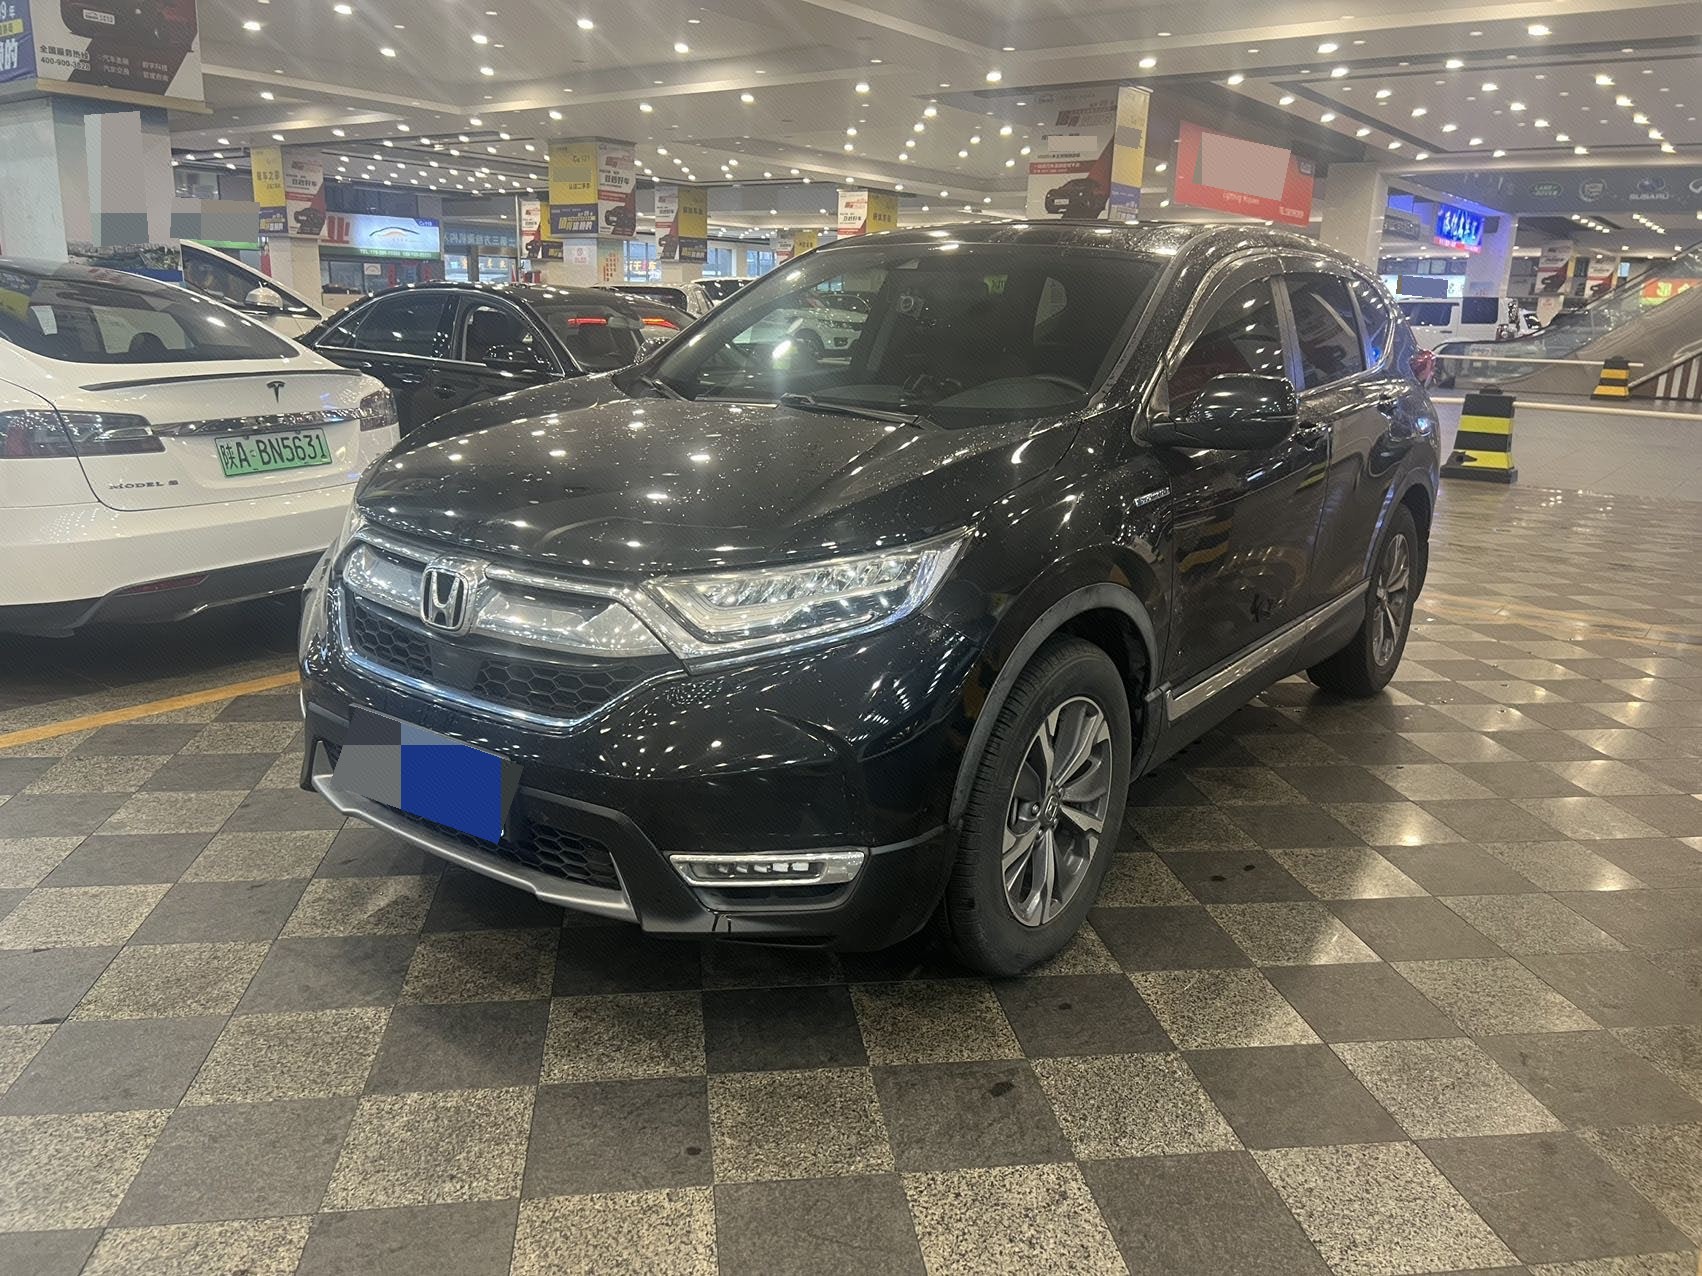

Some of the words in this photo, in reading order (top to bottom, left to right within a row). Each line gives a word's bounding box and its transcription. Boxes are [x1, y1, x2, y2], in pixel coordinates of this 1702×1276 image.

[40, 44, 89, 60] 全国服务热线
[1629, 191, 1670, 200] SUBARU
